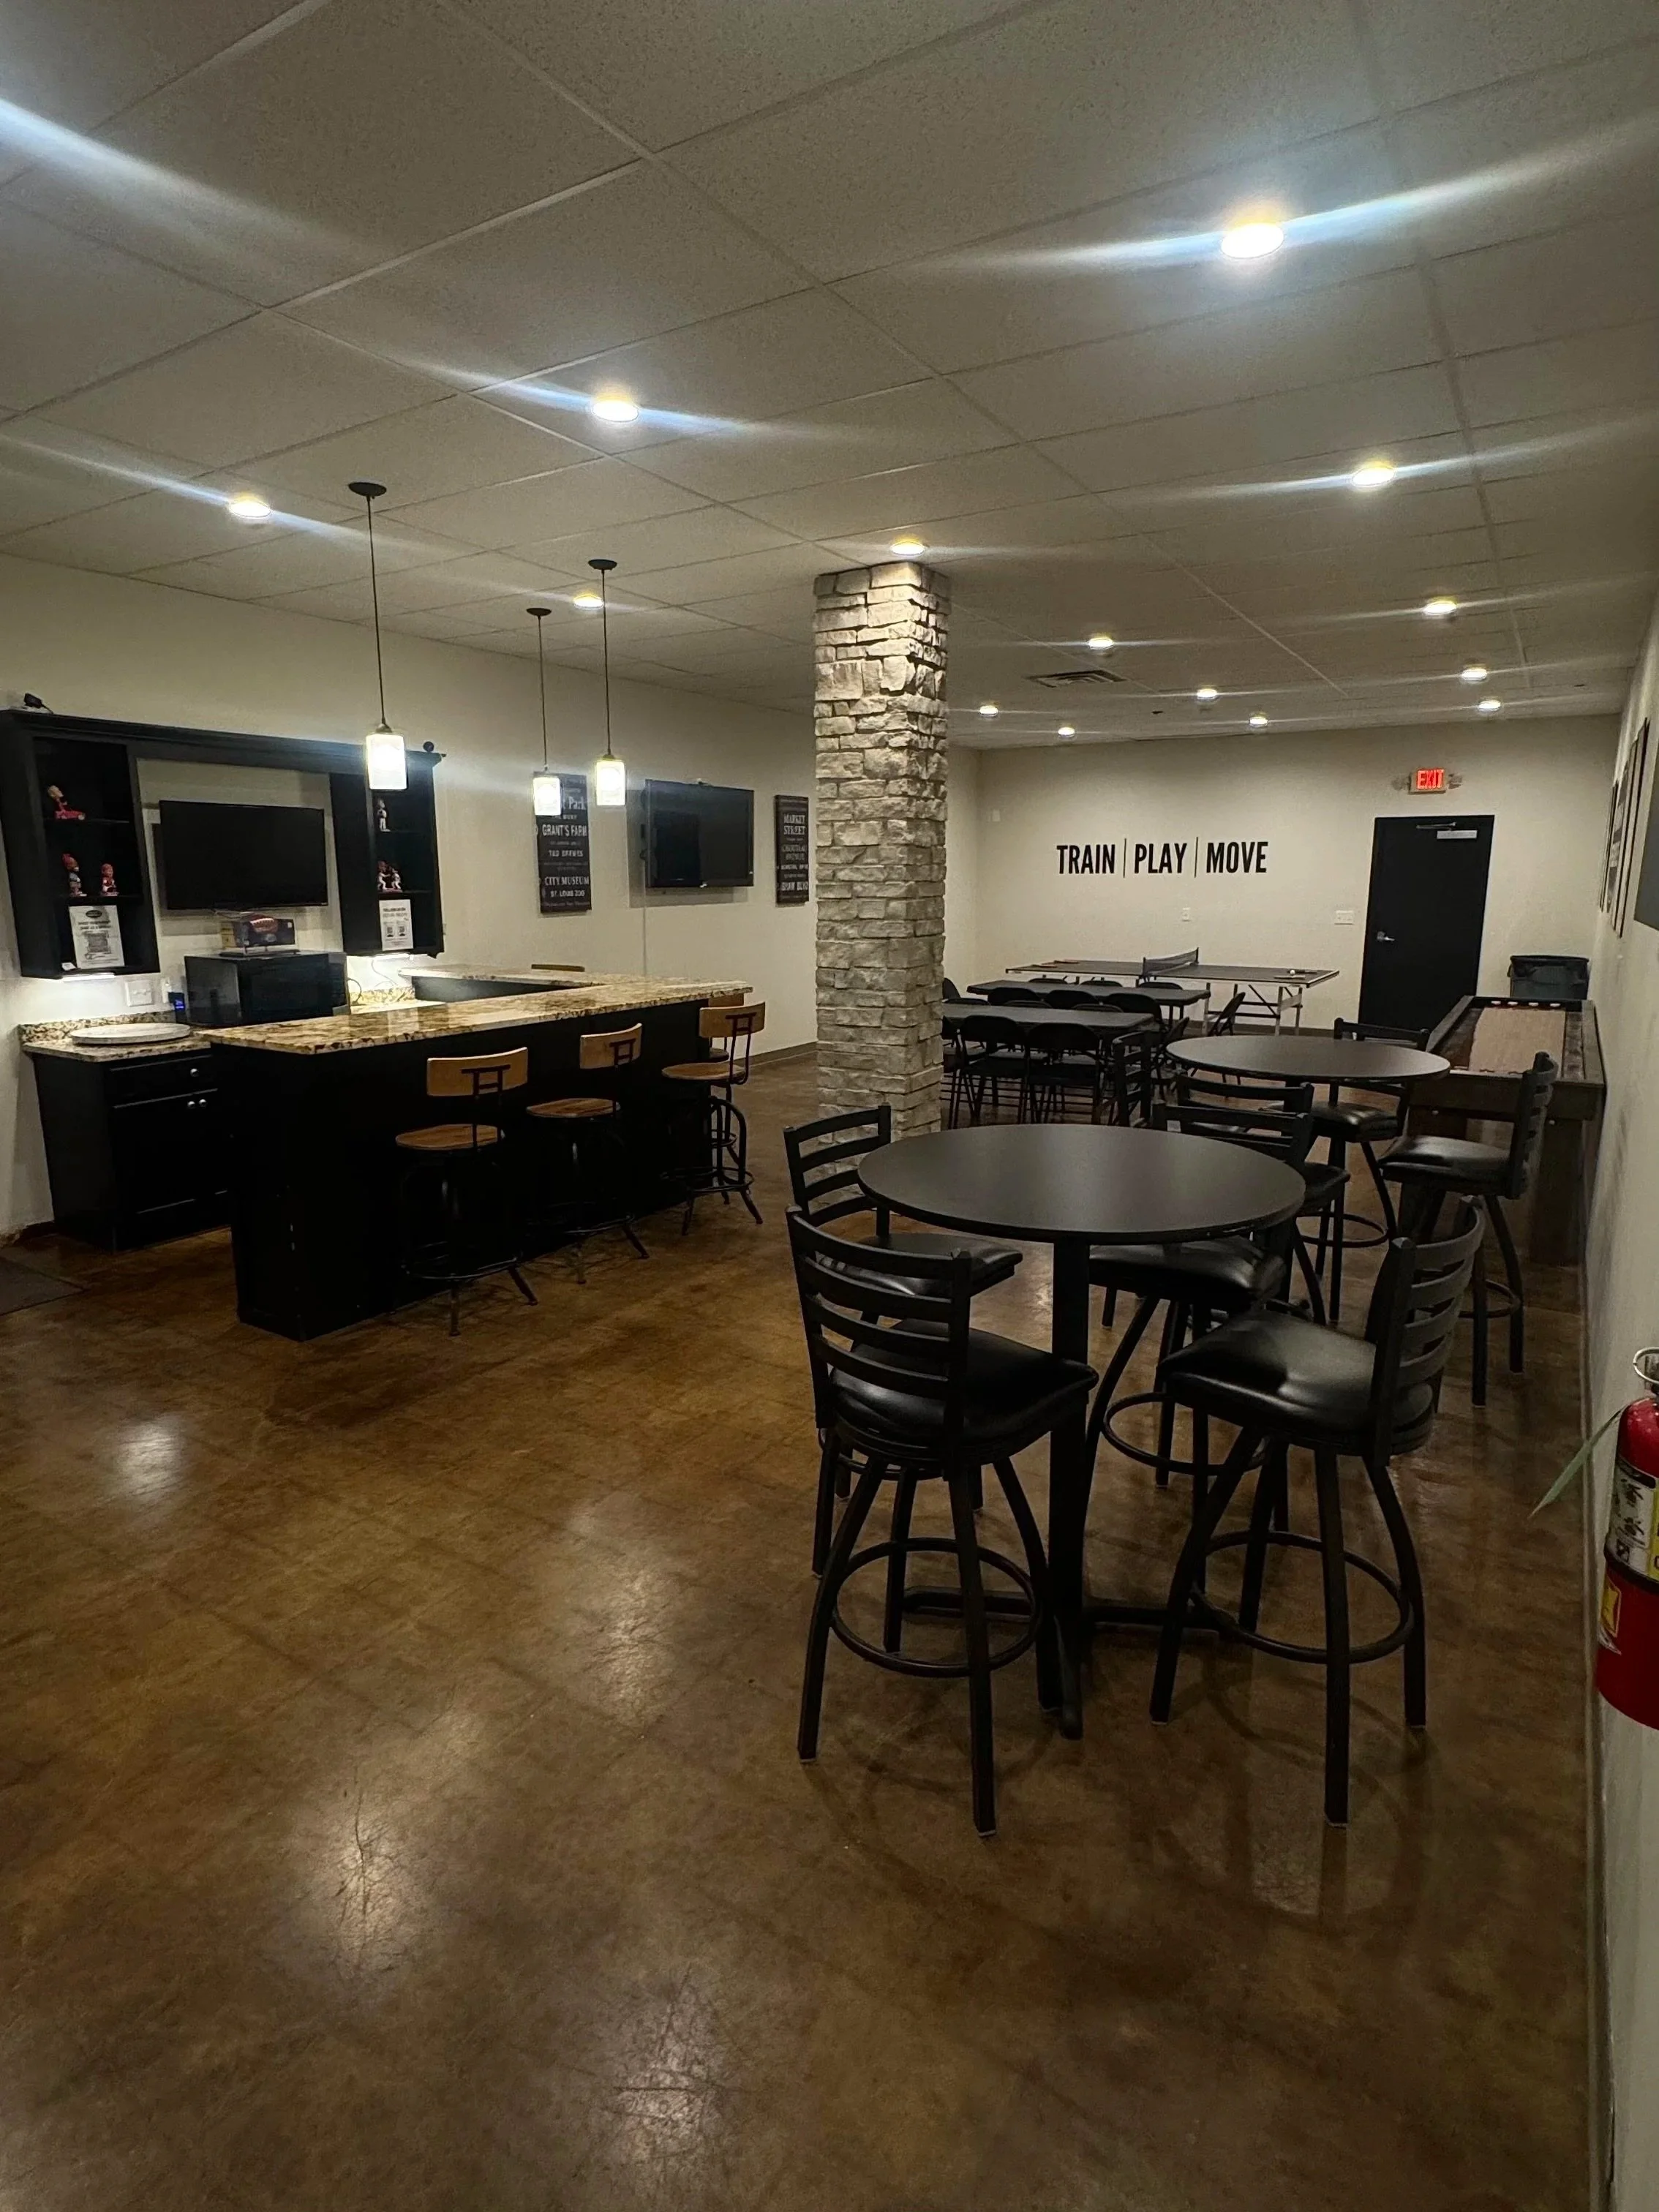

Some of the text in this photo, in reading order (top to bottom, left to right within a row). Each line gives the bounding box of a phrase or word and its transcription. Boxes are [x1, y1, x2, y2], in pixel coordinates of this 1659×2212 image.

[1418, 770, 1444, 789] EXIT
[542, 824, 587, 838] GRANT'S FARM
[783, 825, 805, 835] STREET
[1056, 841, 1268, 874] TRAIN PLAY MOVE
[544, 876, 590, 886] CITY MUSEUM
